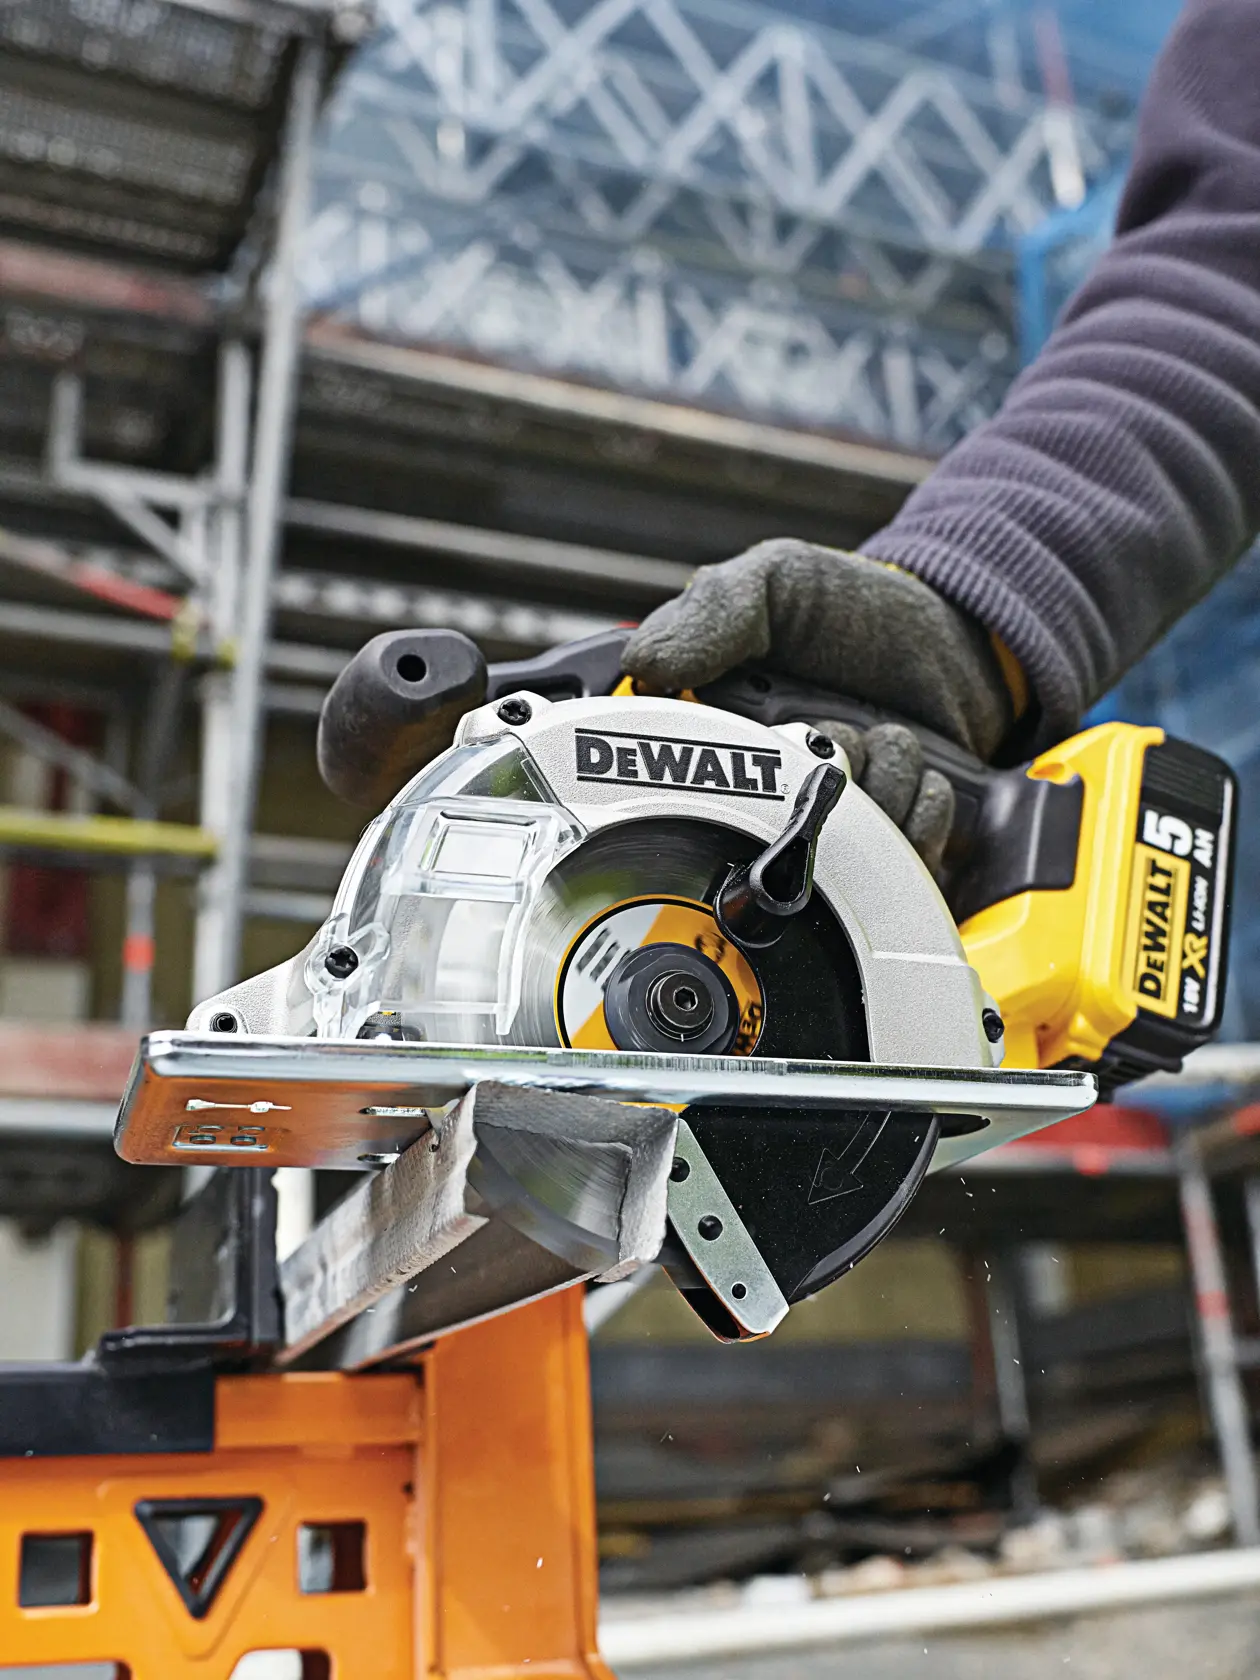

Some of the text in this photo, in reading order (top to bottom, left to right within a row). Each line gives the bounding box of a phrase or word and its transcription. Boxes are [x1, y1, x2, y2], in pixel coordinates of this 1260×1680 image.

[1142, 809, 1193, 857] 5
[1193, 828, 1215, 868] AH
[1138, 859, 1174, 1000] DEWALT
[1182, 932, 1208, 979] XR
